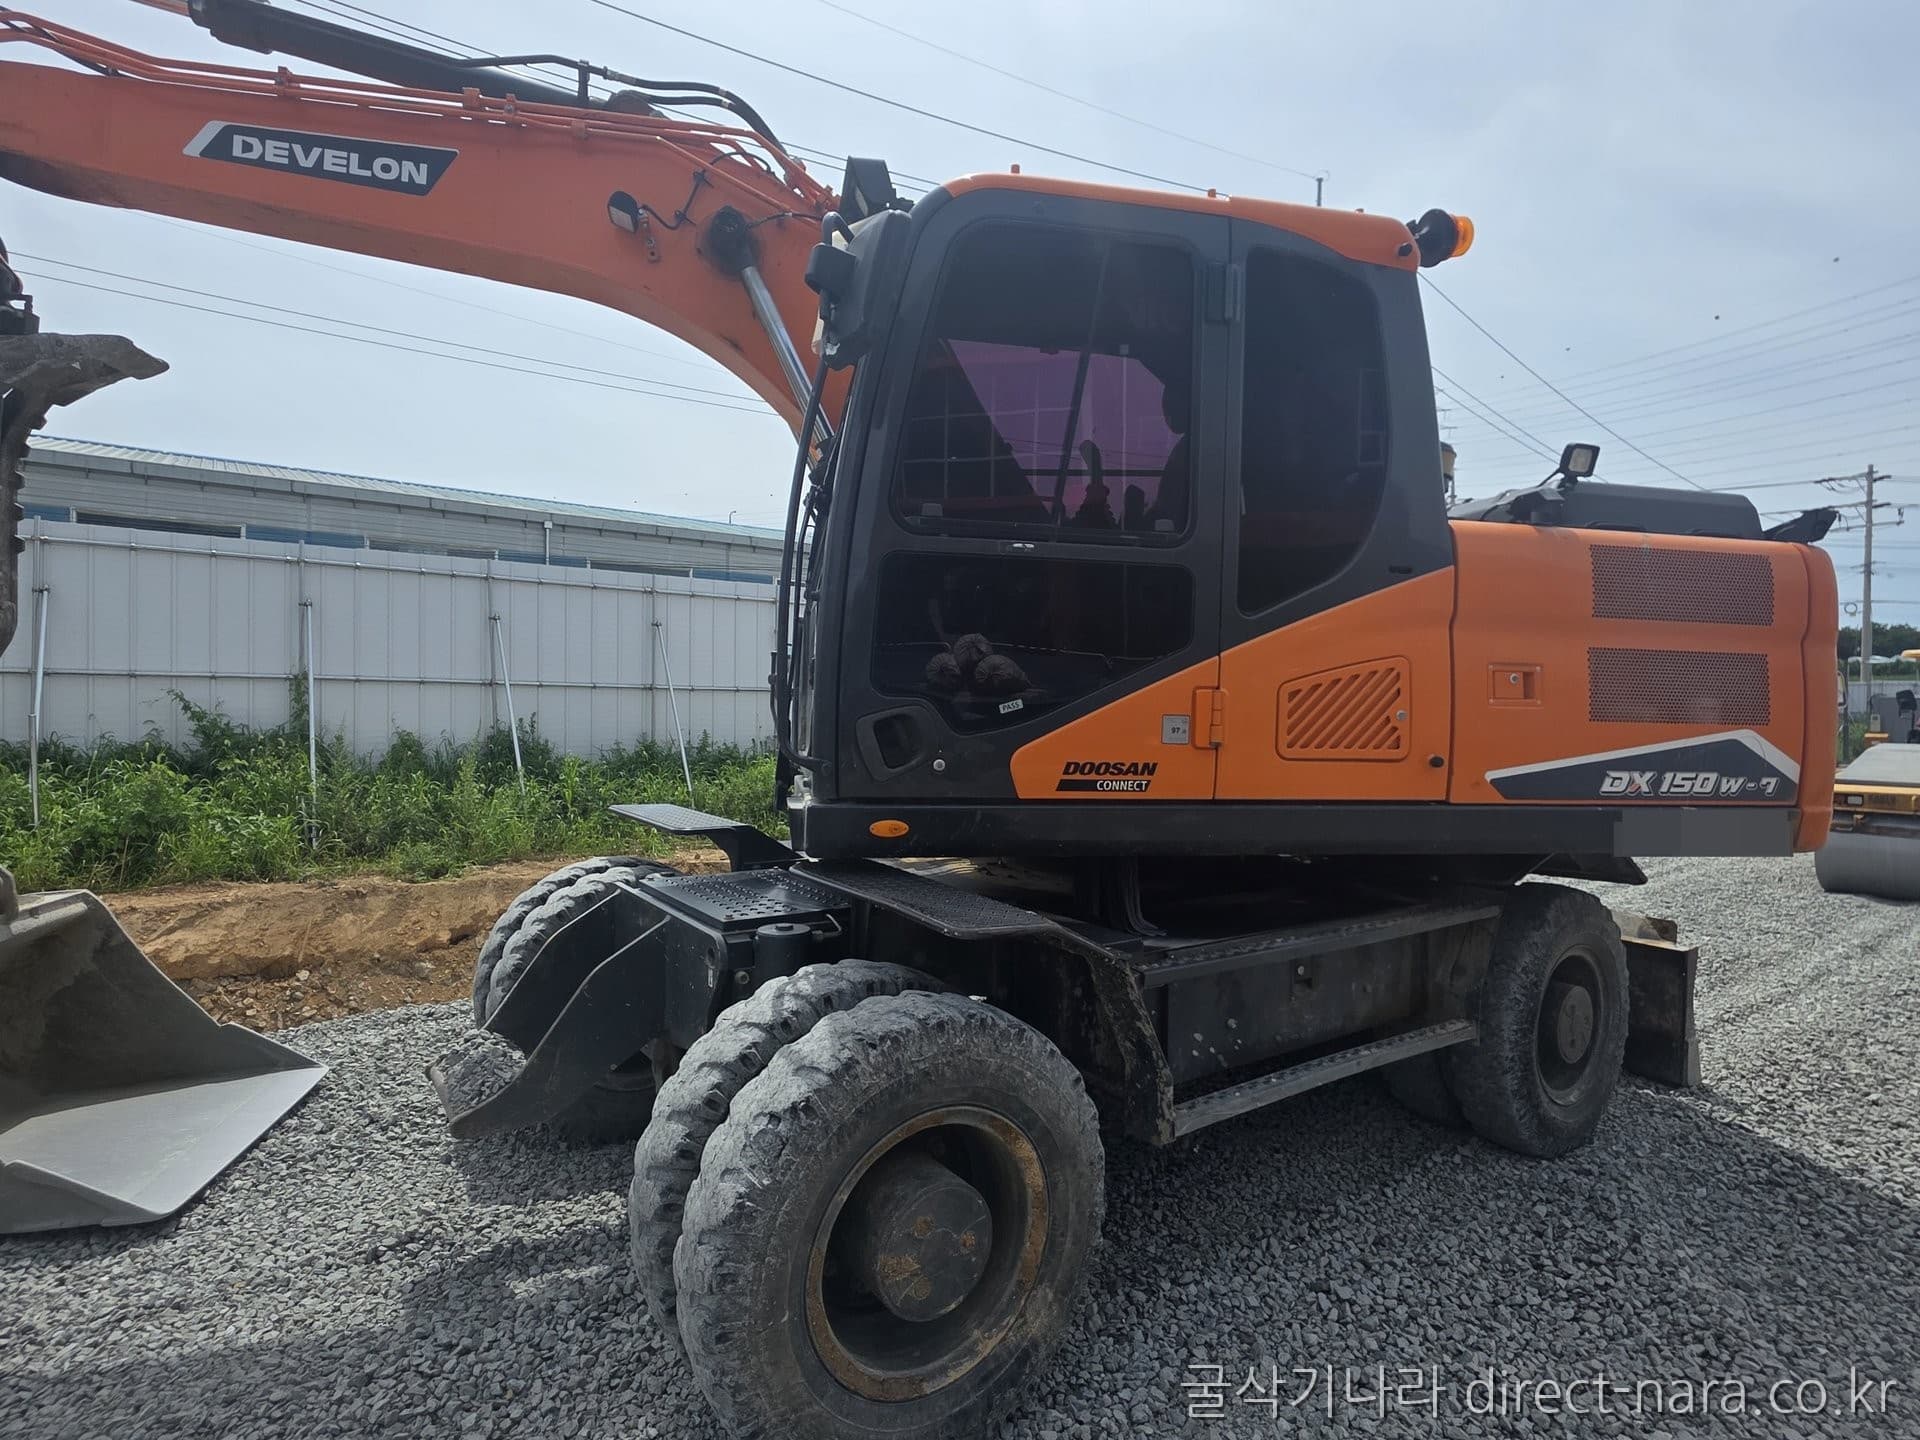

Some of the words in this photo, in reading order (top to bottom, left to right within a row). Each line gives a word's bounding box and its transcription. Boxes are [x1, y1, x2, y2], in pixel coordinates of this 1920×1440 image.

[232, 134, 428, 185] DEVELON
[1062, 761, 1158, 776] DOOSAN
[1096, 780, 1148, 792] CONNECT
